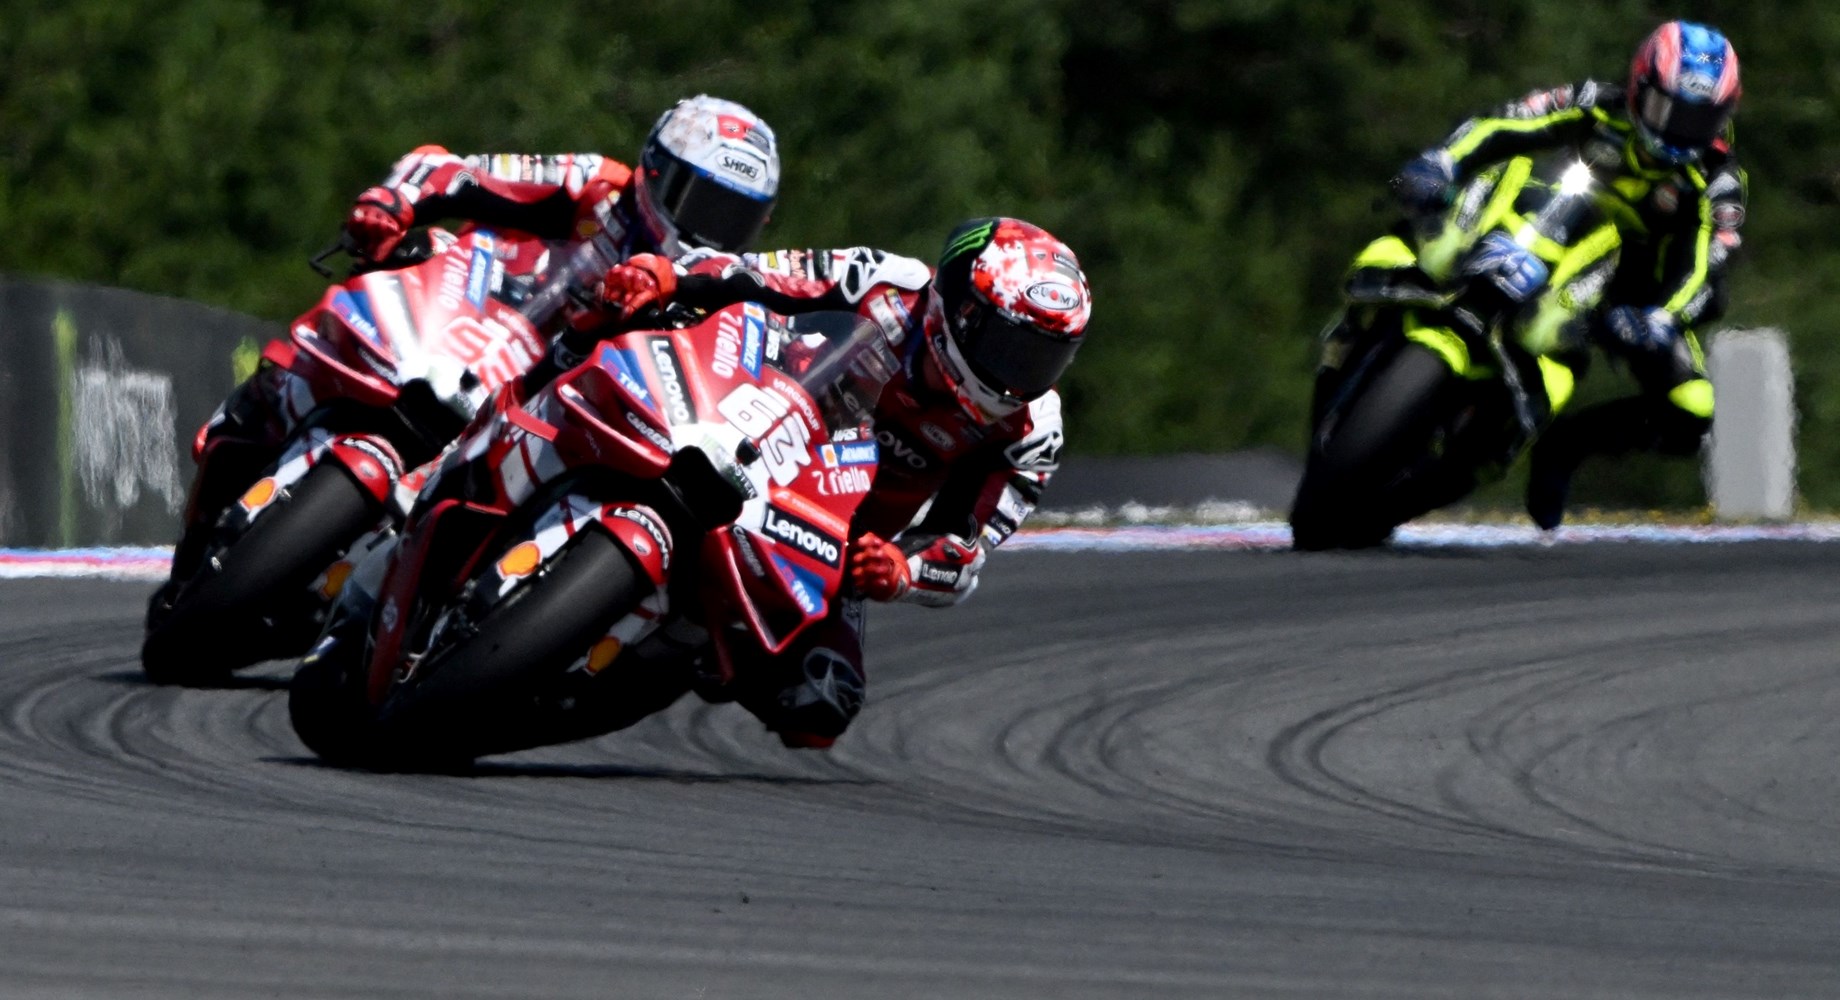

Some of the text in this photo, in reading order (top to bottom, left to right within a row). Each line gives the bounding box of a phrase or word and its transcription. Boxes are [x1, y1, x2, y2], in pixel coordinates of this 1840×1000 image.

[723, 155, 760, 179] SHOEI
[711, 321, 742, 379] riello
[620, 371, 648, 400] TIM
[651, 340, 690, 421] Lenovo
[828, 466, 872, 495] riello
[614, 507, 670, 571] Lenovo
[766, 508, 839, 562] Lenovo
